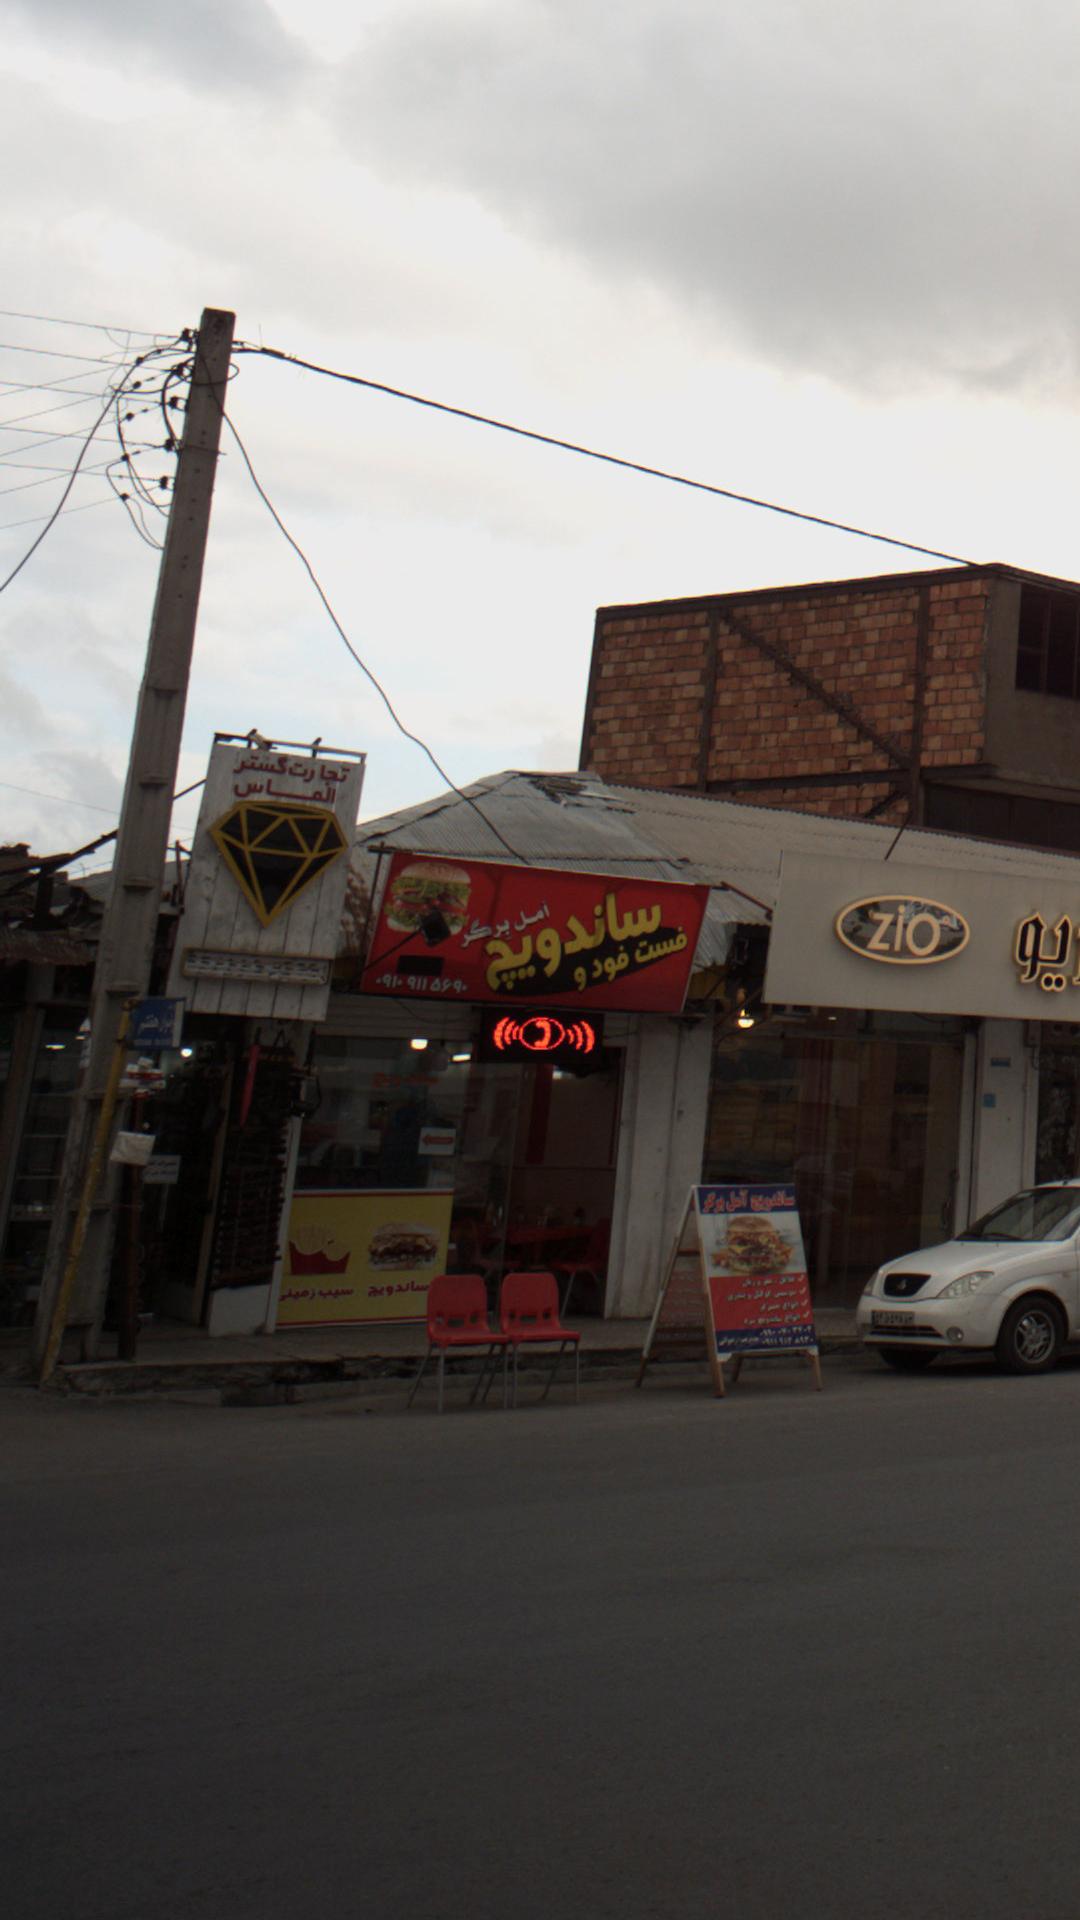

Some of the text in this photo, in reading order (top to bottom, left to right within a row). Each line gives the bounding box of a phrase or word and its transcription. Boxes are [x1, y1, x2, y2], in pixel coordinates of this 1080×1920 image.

[232, 754, 351, 783] تجارت گستر
[233, 778, 337, 804] الماس
[484, 891, 663, 992] ساندویچ
[573, 926, 689, 993] فست فود و
[375, 973, 403, 988] ۰۹۱۰
[407, 975, 428, 991] ۹۱۱
